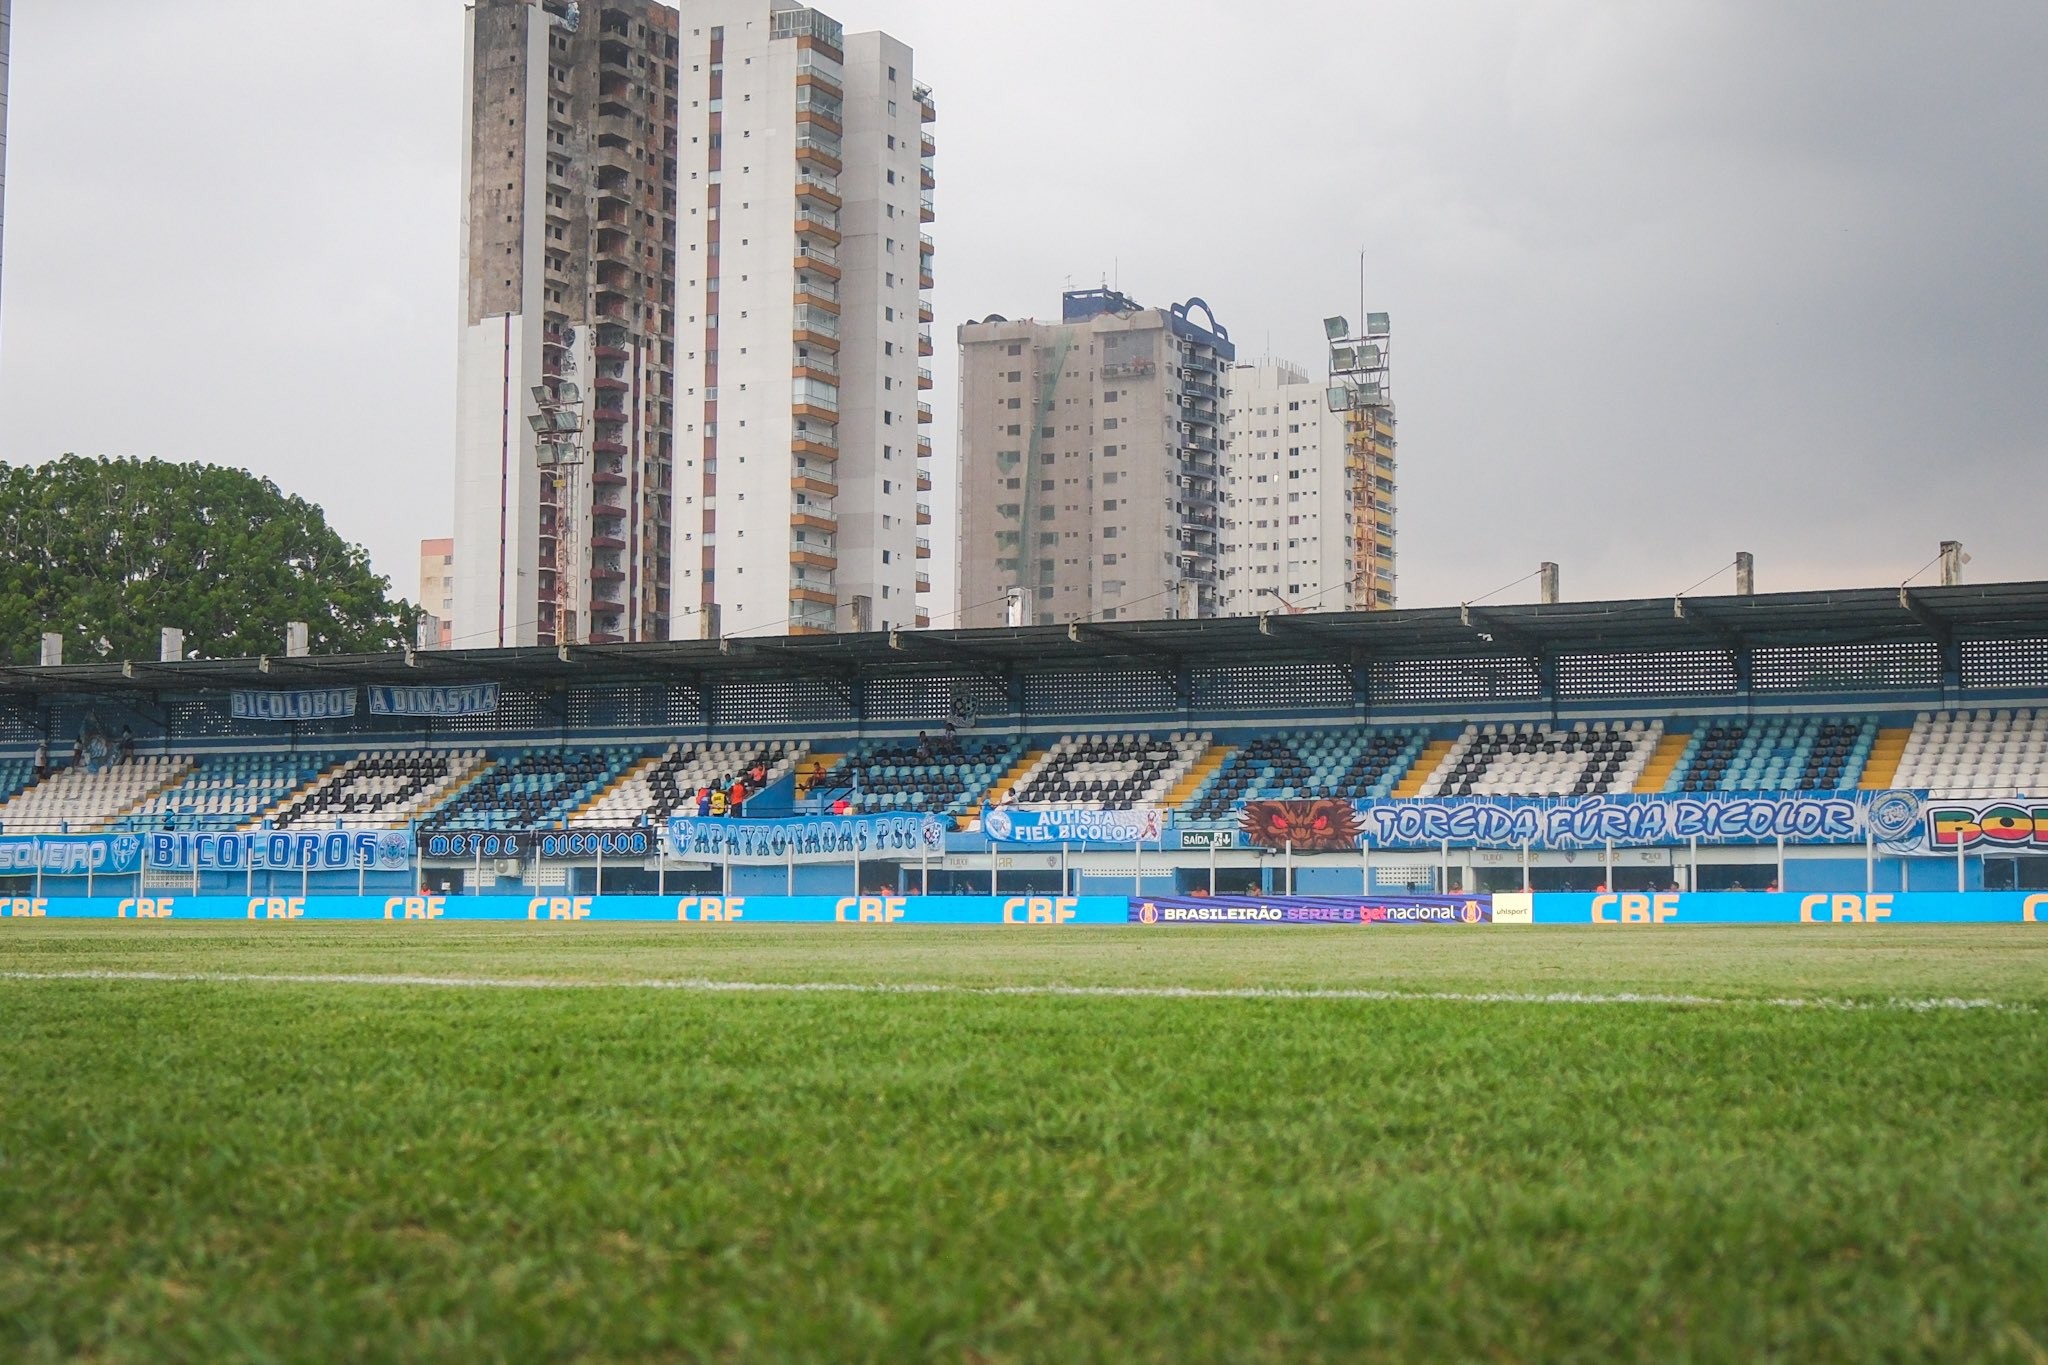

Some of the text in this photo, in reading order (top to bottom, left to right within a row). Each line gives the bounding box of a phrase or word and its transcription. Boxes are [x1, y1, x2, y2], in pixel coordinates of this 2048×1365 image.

[233, 690, 356, 717] BICOLOBOS
[371, 686, 497, 713] A DINASTIA
[1038, 809, 1116, 826] AUTISTA
[1373, 804, 1540, 844] TORCIDA
[1547, 796, 1667, 845] FÚRIA
[1674, 799, 1856, 839] BICOLOR
[429, 834, 518, 856] METAL
[542, 832, 648, 857] BICOLOR
[876, 817, 917, 850] PSC
[1015, 824, 1140, 841] FIEL BICOLOR
[1183, 832, 1210, 845] SAÍDA
[151, 832, 378, 868] BICOLOBOS
[118, 898, 175, 917] CBF
[247, 898, 306, 918] CBF
[384, 897, 447, 919] CBF
[528, 897, 593, 920] CBF
[677, 897, 745, 921] CBF
[835, 897, 907, 922] CBF
[1003, 897, 1078, 923] CBF
[1164, 905, 1282, 921] BRASILEIRÃO
[1288, 905, 1340, 919] SÉRIE
[1497, 908, 1528, 917] uhlsport
[1591, 895, 1680, 923] CBF
[1800, 895, 1894, 922] CBF
